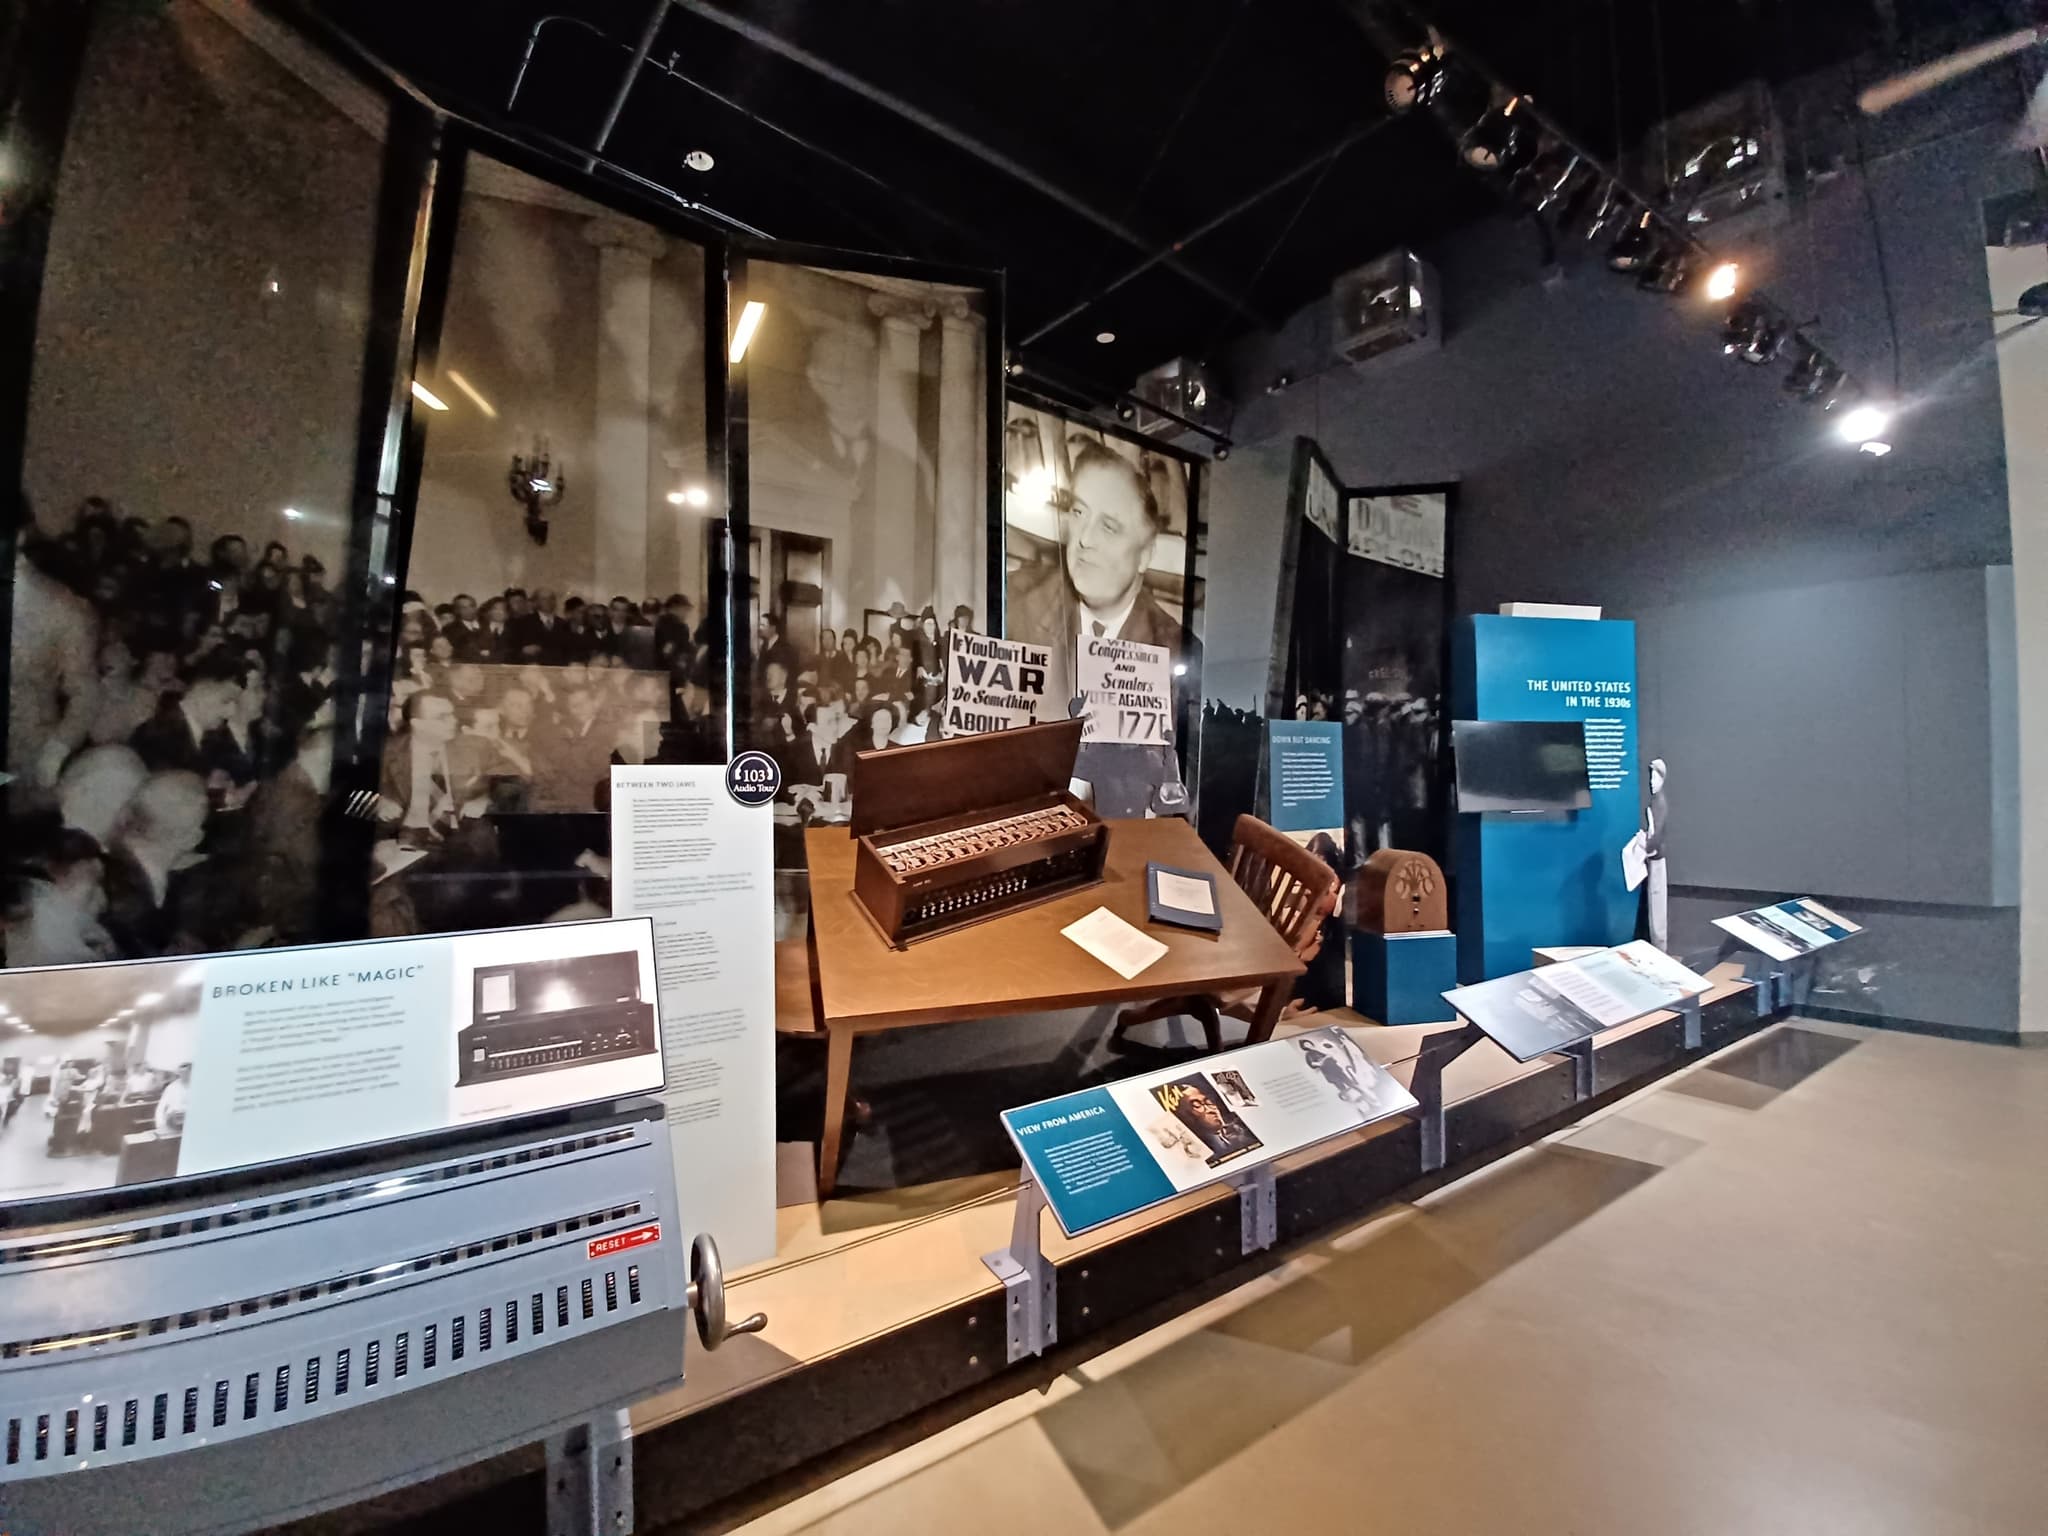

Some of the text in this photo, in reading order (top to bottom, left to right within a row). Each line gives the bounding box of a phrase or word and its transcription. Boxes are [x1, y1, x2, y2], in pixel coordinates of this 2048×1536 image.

[956, 655, 1045, 695] WAR
[1114, 663, 1136, 673] AND
[1101, 672, 1154, 692] Senators
[1527, 679, 1631, 693] THE UNITED STATES
[951, 685, 1037, 714] Do Something
[1565, 696, 1632, 709] IN THE 1930s
[743, 769, 767, 783] 103
[616, 781, 654, 789] BETWEEN
[656, 780, 675, 788] TWO
[733, 784, 775, 793] Audio Tour
[212, 979, 294, 999] BROKEN
[301, 974, 342, 990] LIKE
[1016, 1106, 1106, 1137] VIEW FROM AMERICA
[595, 1237, 626, 1252] RESET
